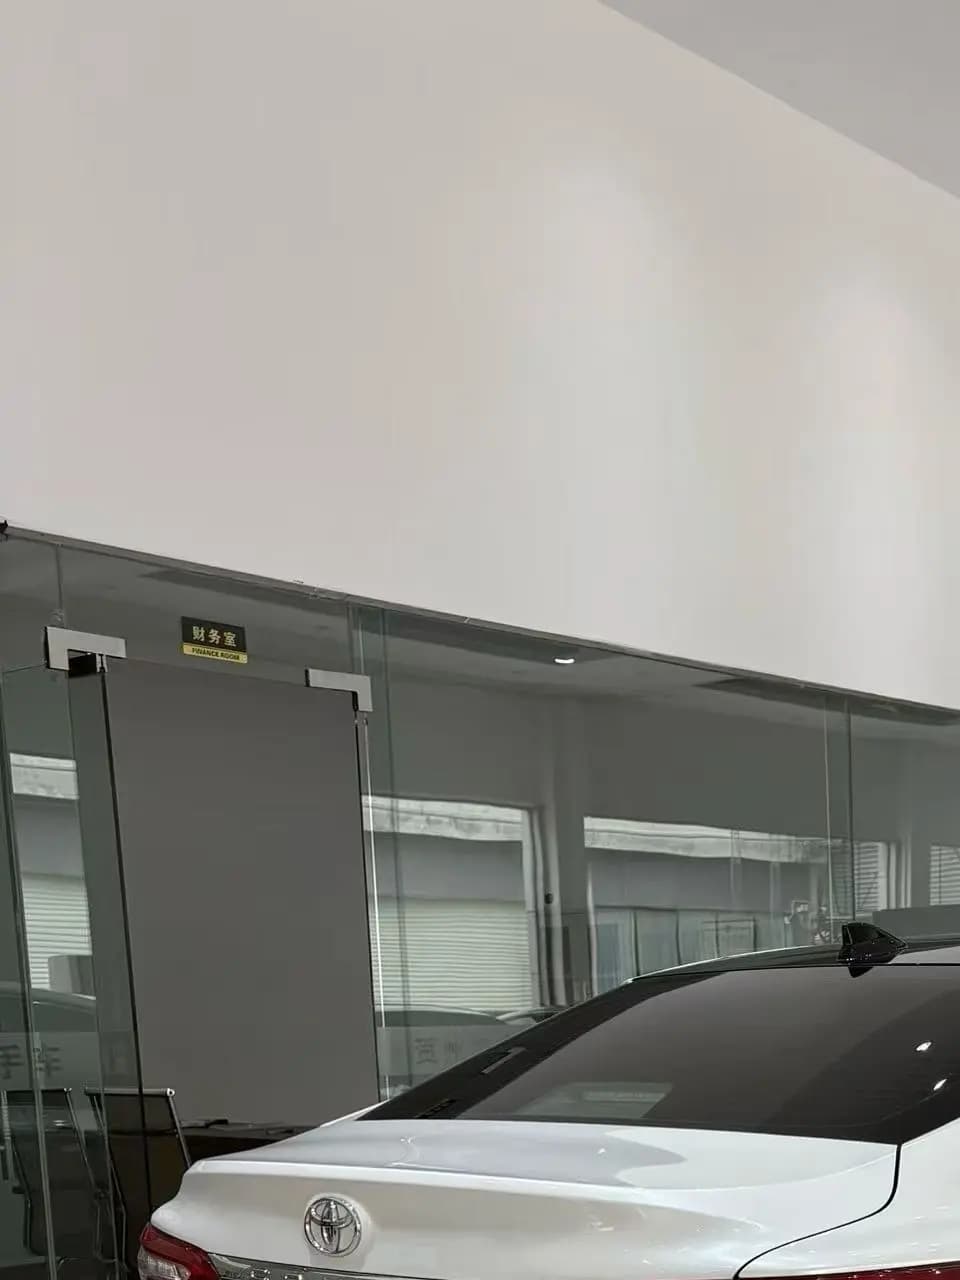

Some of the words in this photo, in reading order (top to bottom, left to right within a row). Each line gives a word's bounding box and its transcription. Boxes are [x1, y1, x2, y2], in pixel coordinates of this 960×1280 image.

[192, 625, 237, 647] 财务室
[192, 647, 219, 657] FINANCE
[221, 652, 240, 660] ROOM
